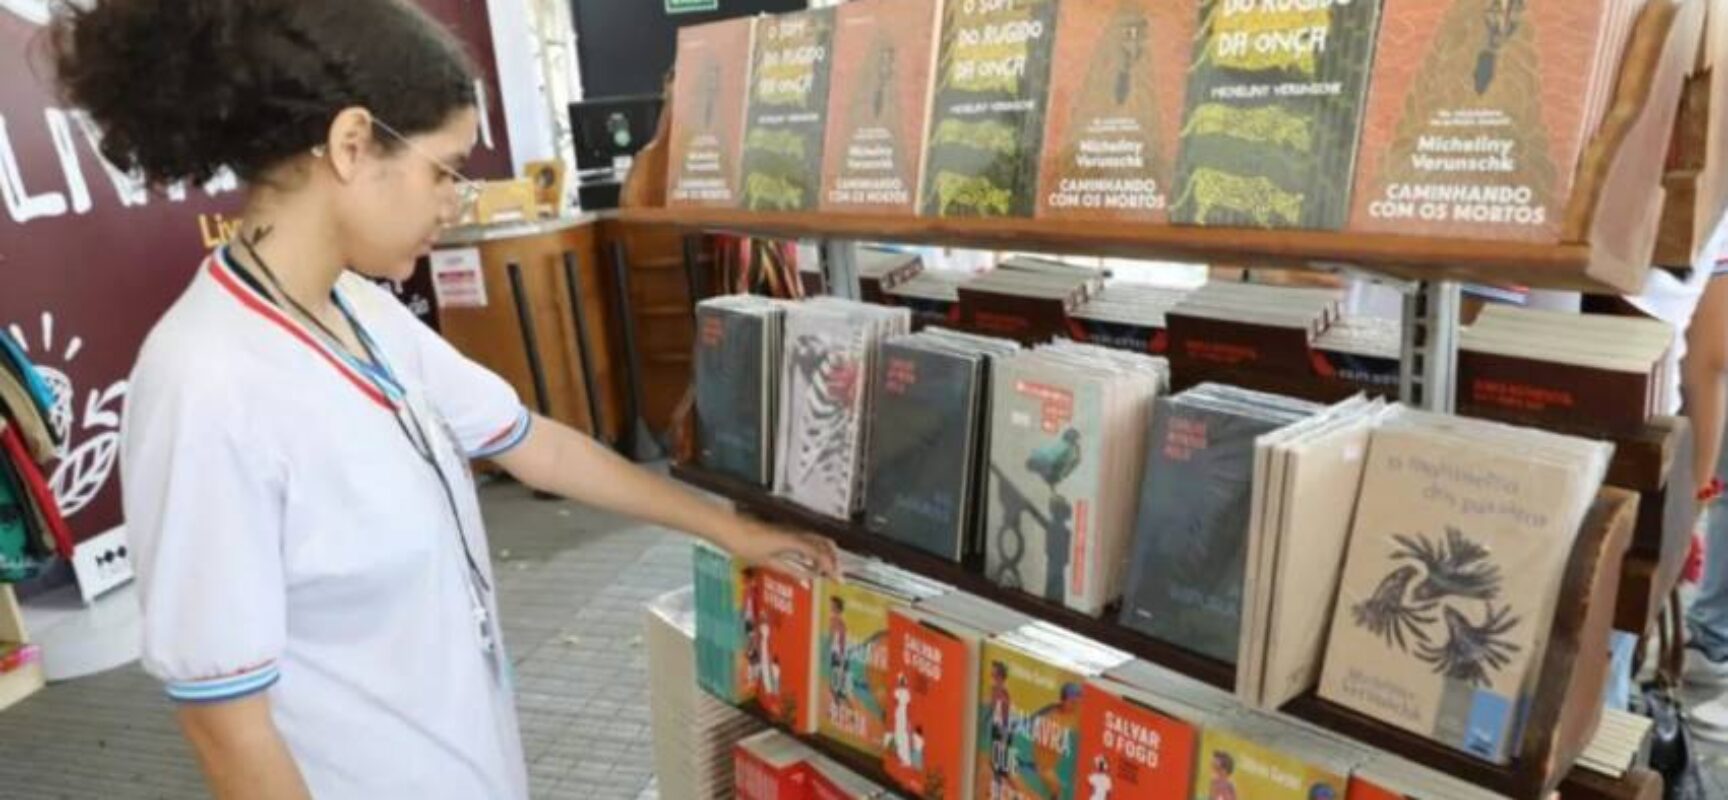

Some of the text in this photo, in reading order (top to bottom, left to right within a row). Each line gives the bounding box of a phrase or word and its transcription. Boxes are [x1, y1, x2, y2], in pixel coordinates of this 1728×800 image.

[1217, 25, 1326, 58] DA ONÇA
[1417, 134, 1514, 158] Micheliny
[1411, 152, 1514, 172] Verunschk
[1059, 179, 1155, 193] CAMINHANDO
[1386, 182, 1532, 204] CAMINHANDO
[1048, 192, 1165, 209] COM OS MORTOS
[1368, 200, 1546, 225] COM OS MORTOS
[1104, 710, 1160, 751] SALVAR
[1103, 729, 1158, 769] O FOGO
